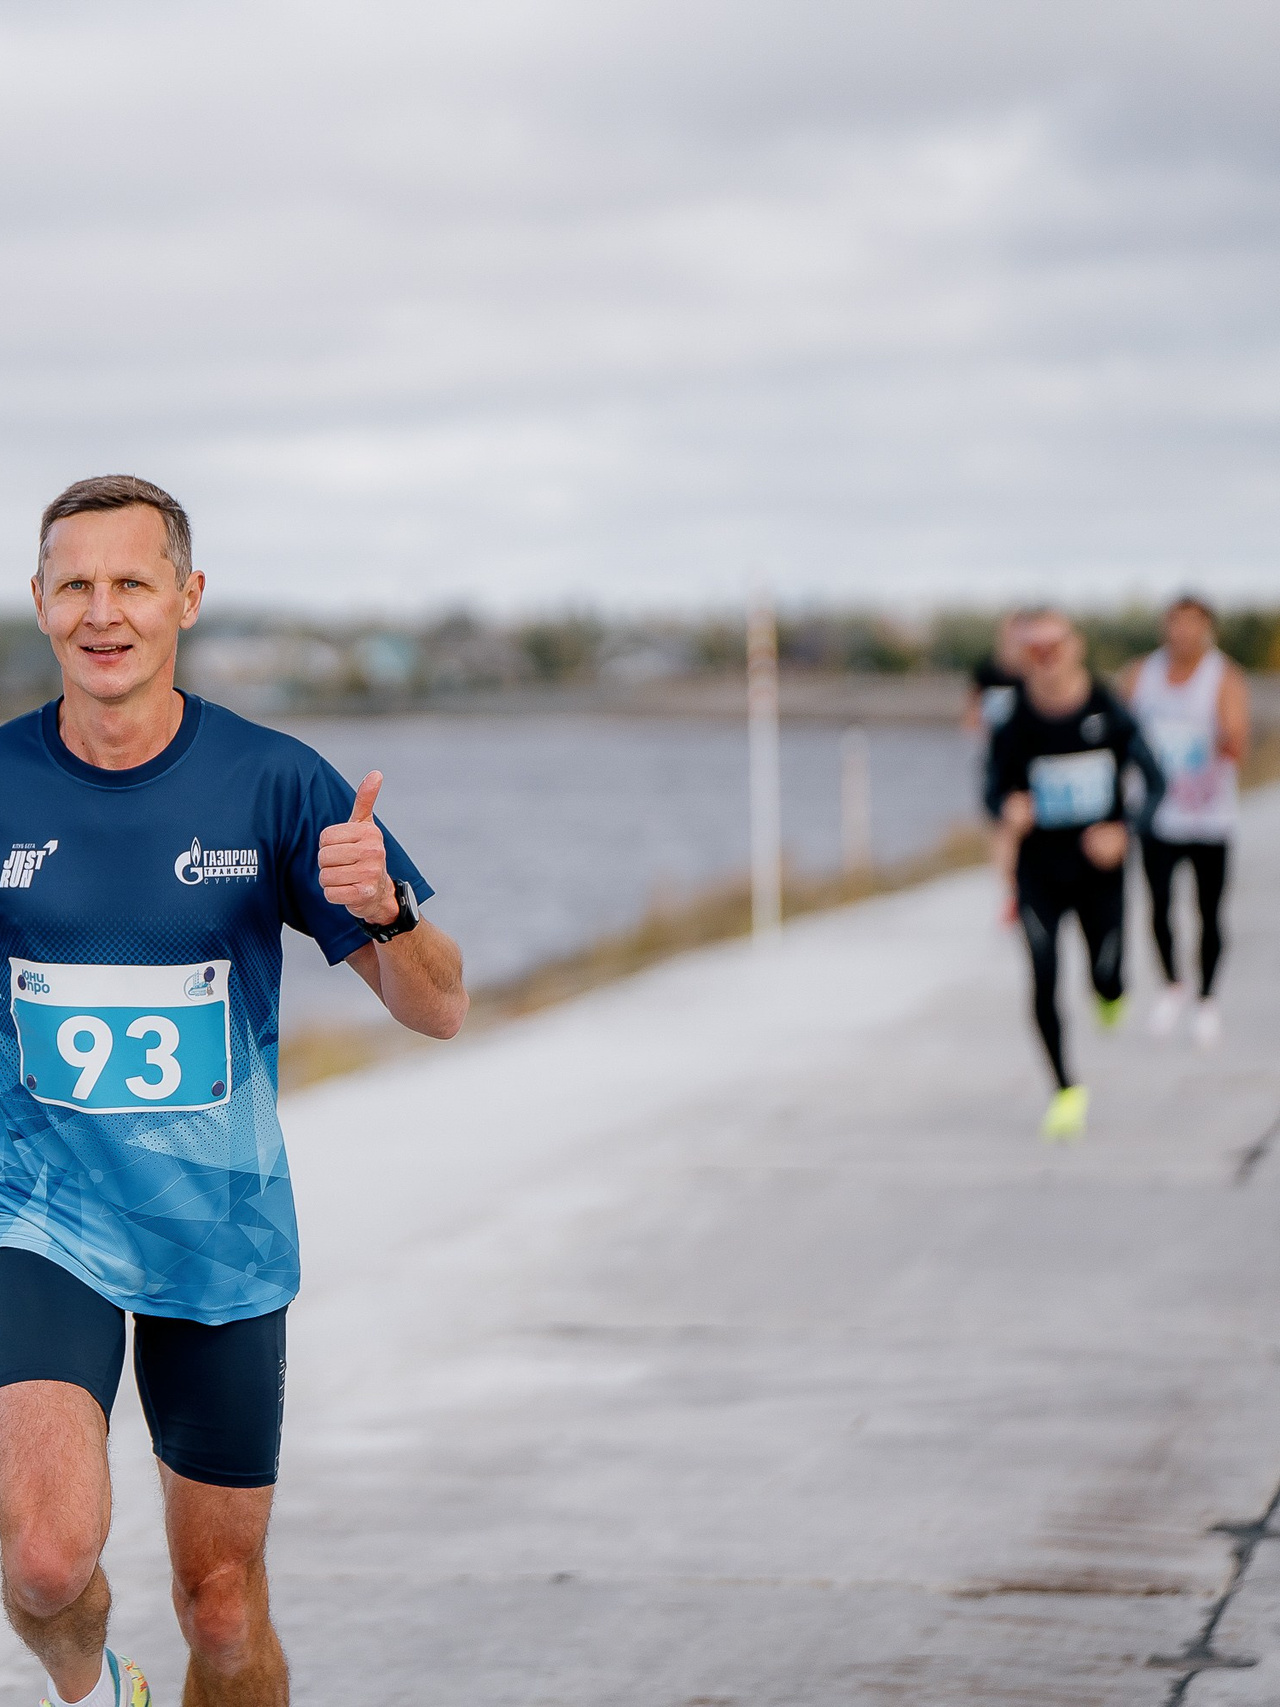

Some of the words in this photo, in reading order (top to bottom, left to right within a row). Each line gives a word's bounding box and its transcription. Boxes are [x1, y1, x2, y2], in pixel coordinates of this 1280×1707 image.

[3, 850, 46, 870] JUST
[203, 849, 258, 866] ГАЗПРОМ
[0, 869, 34, 888] RUN
[206, 867, 256, 875] ТРАНСГАЗ
[204, 876, 257, 885] СУРГУТ
[56, 1014, 182, 1101] 93
